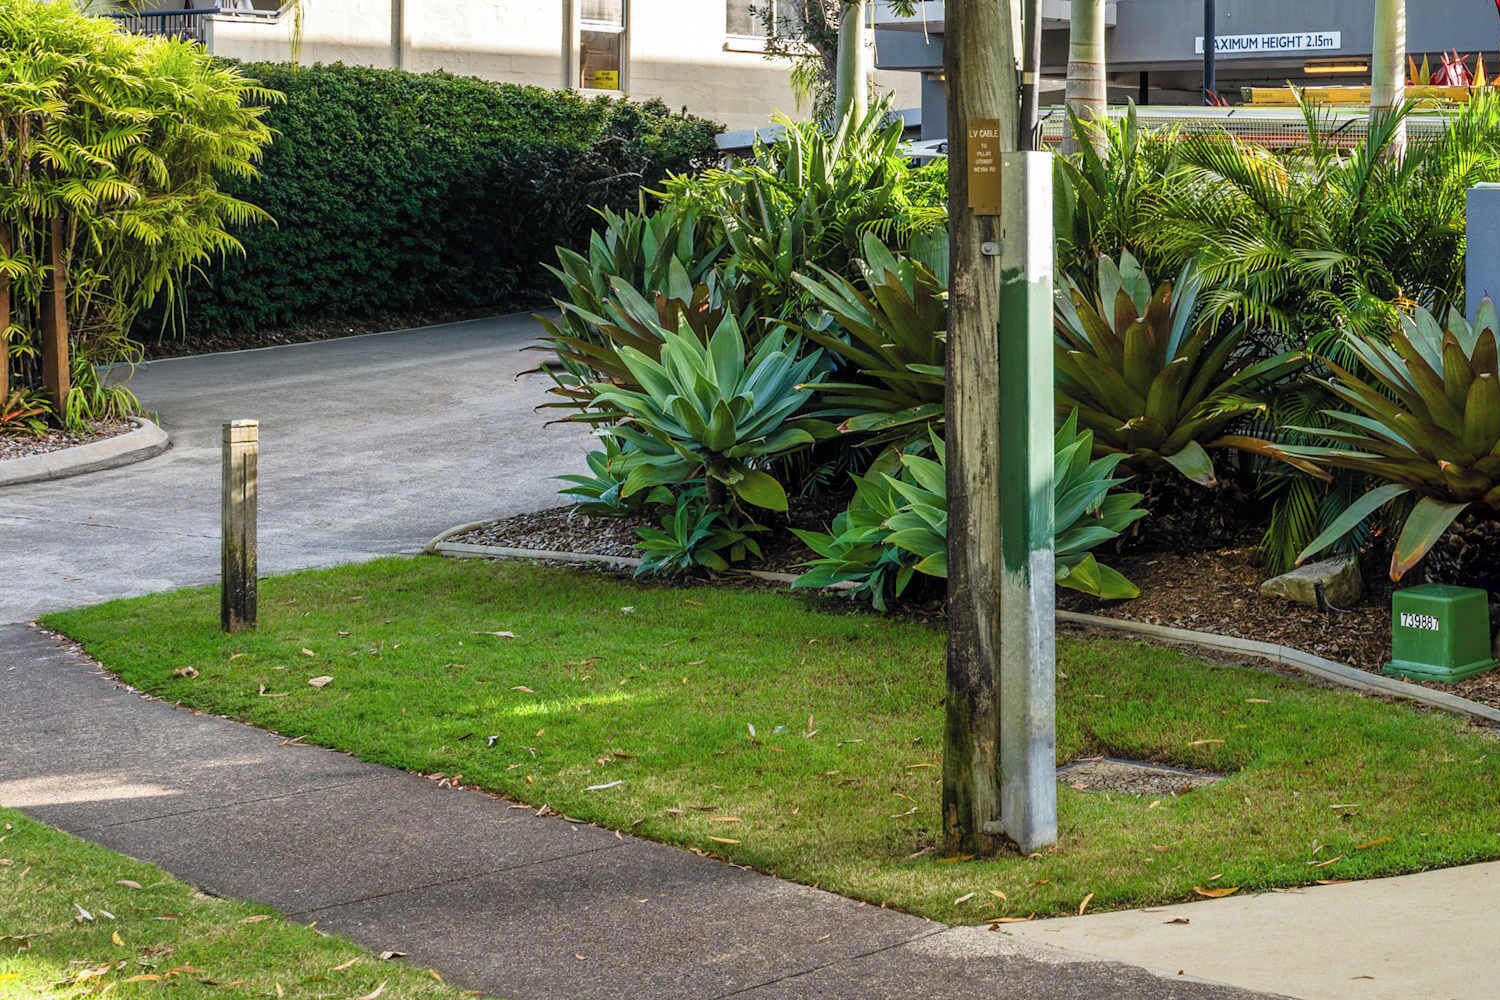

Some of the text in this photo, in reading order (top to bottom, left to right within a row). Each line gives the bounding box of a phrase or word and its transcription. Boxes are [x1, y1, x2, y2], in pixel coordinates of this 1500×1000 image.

[1203, 35, 1333, 53] AXIMUM HEIGHT 2.15m
